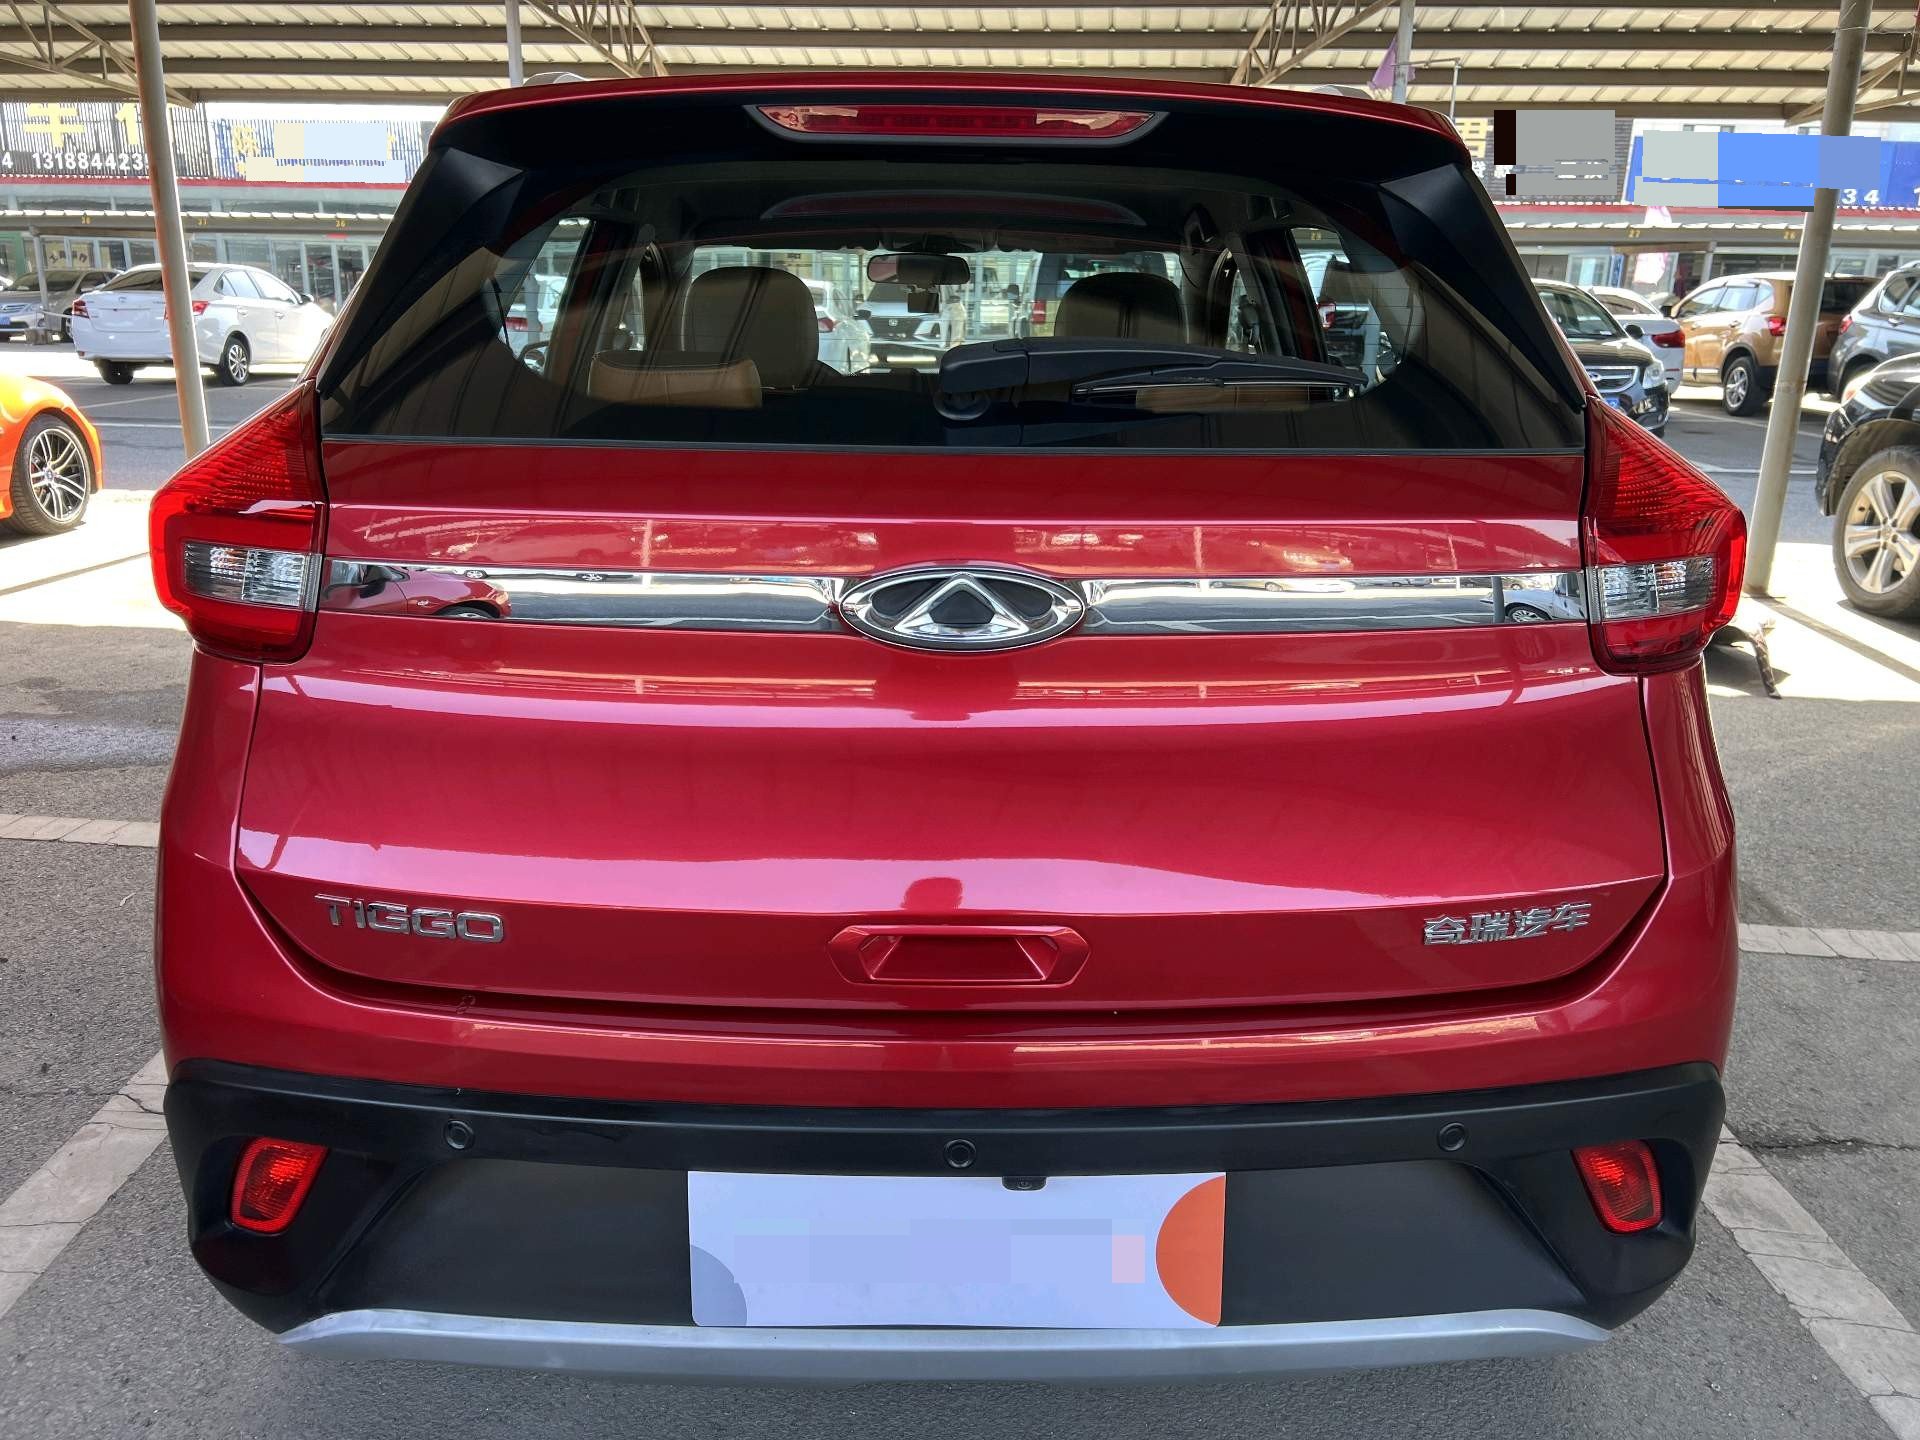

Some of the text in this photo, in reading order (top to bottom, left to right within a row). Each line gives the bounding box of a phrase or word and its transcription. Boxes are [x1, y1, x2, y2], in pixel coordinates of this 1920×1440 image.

[32, 151, 149, 171] 131884423
[314, 893, 505, 943] TIGGO
[1423, 902, 1592, 945] 奇瑞汽车
